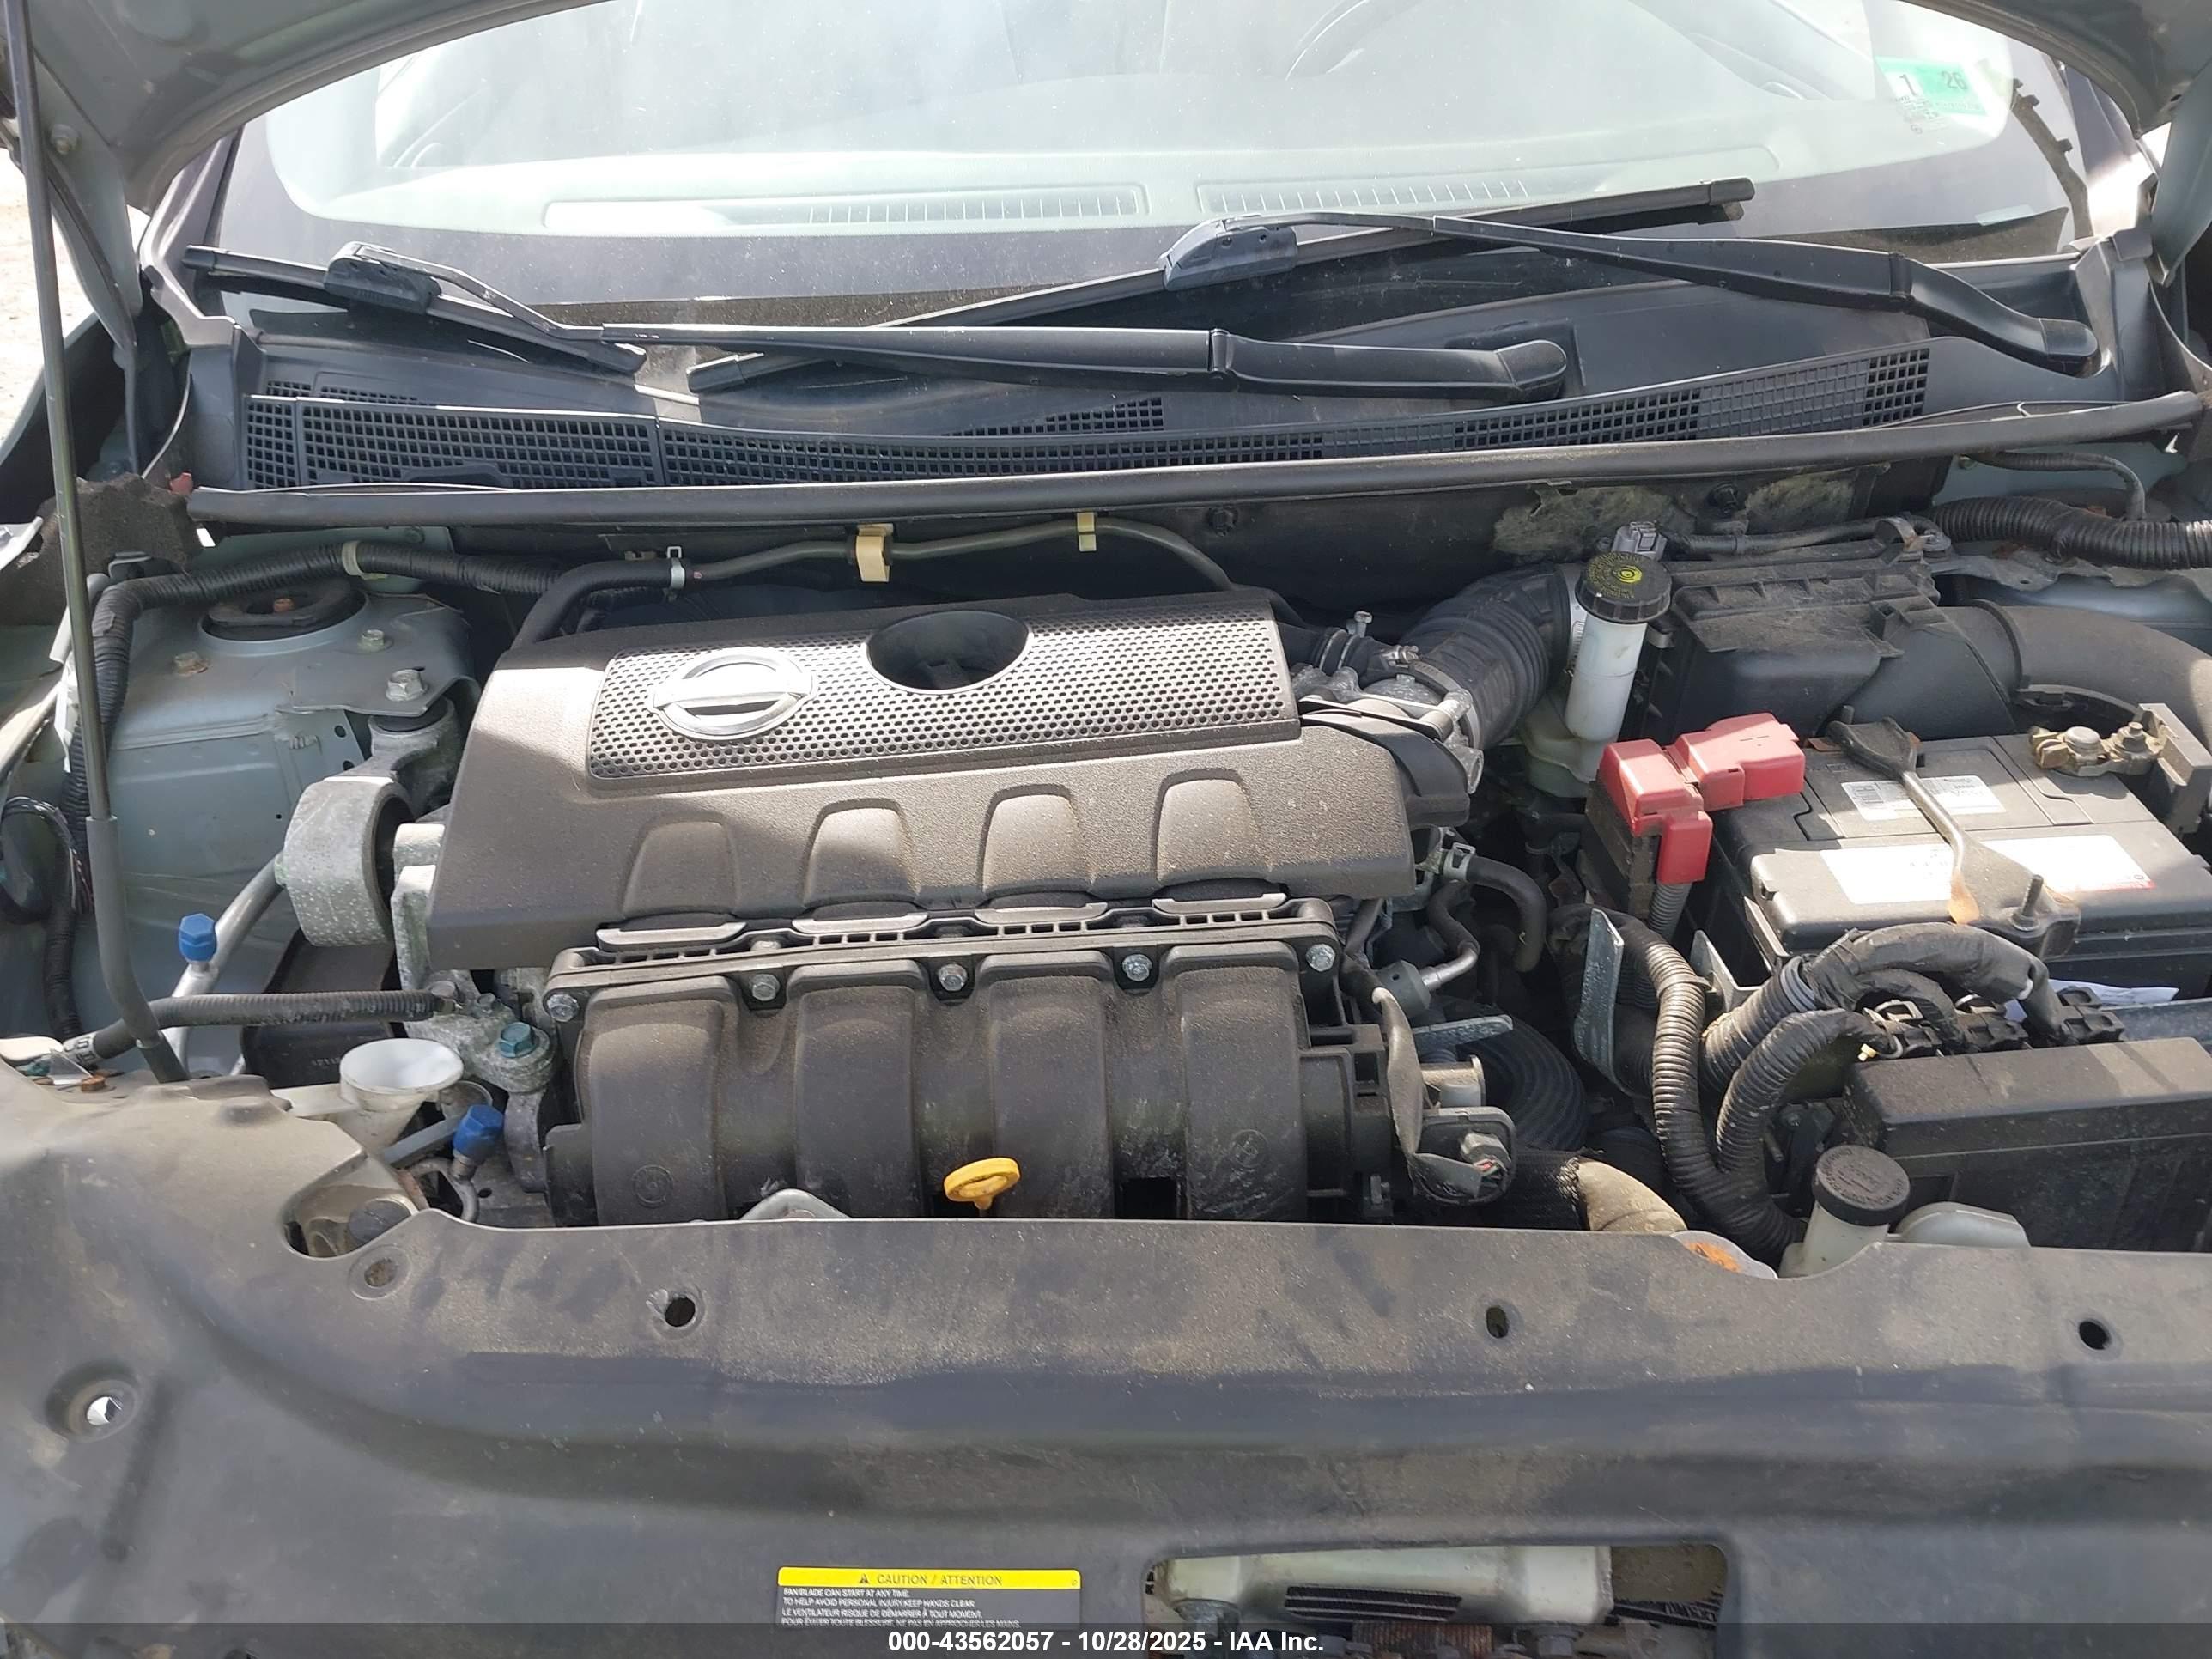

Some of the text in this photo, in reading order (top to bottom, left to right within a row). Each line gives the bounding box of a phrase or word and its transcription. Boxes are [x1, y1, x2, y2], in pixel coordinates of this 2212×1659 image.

[1899, 70, 1969, 96] 1 26
[878, 1574, 927, 1585] CAUTION
[941, 1575, 1003, 1586] ATTENTION
[799, 1588, 823, 1596] BLADE
[824, 1589, 842, 1597] CAN
[842, 1589, 865, 1597] START
[866, 1589, 874, 1598] AT
[875, 1589, 890, 1598] ANY
[783, 1597, 794, 1606] TO
[794, 1597, 815, 1606] HELP
[815, 1598, 837, 1607] AVOID
[839, 1598, 878, 1607] PERSONAL
[878, 1599, 902, 1607] INJURY
[903, 1599, 922, 1607] KEEP
[923, 1599, 950, 1607] HANDS
[782, 1607, 792, 1616] LE
[793, 1608, 841, 1617] VENTILATEUR
[841, 1608, 868, 1618] RISQUE
[870, 1609, 880, 1618] DE
[929, 1609, 948, 1619] TOUT
[781, 1617, 804, 1626] POUR
[830, 1618, 855, 1626] TOUTE
[896, 1619, 907, 1627] NE
[908, 1619, 922, 1627] PAS
[923, 1619, 934, 1628] EN
[981, 1620, 995, 1628] LES
